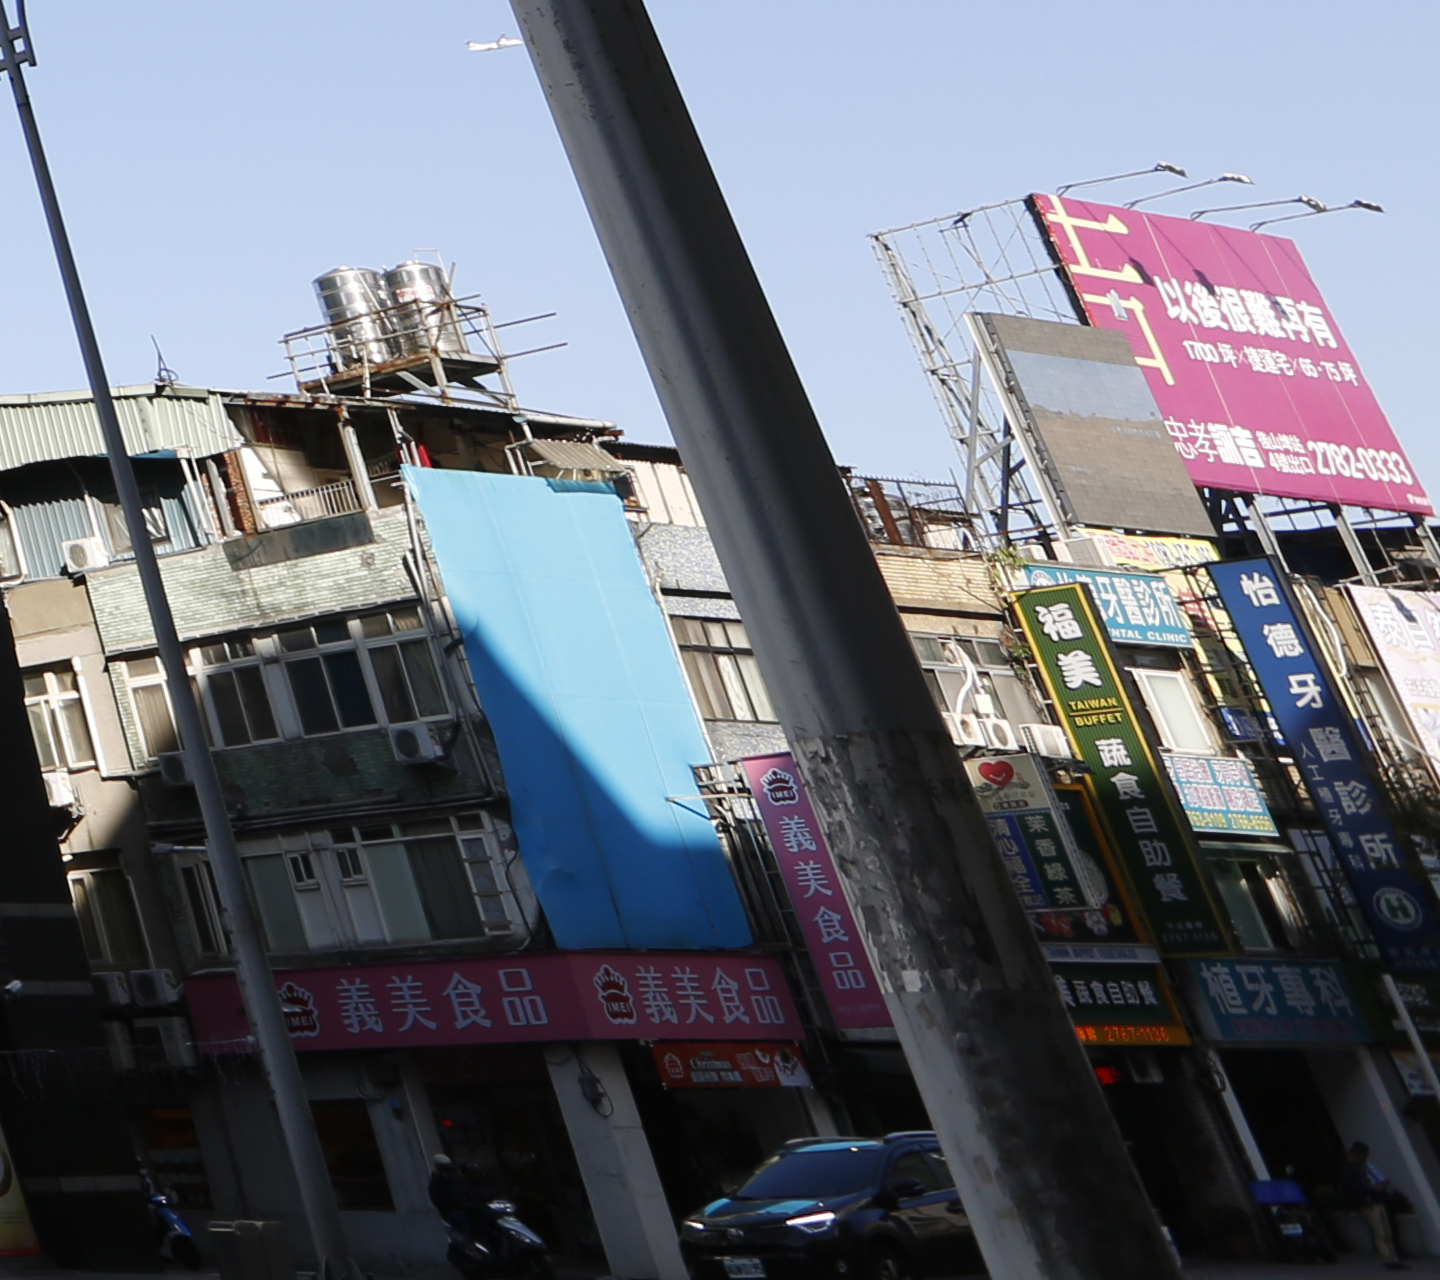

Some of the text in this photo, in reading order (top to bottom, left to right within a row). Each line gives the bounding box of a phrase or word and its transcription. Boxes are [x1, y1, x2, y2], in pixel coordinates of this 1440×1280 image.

[1154, 275, 1339, 350] 以後很難再有
[1305, 441, 1414, 486] 2782-0333
[1035, 602, 1104, 690] 福美
[1147, 630, 1187, 644] CLINIC
[1068, 697, 1119, 711] TAIWAN
[1074, 712, 1125, 727] BUFFET
[1240, 571, 1401, 870] 怡德牙醫診所
[1094, 738, 1188, 902] 蔬食自助餐
[777, 814, 867, 990] 義美食品
[335, 968, 549, 1035] 義美食品
[635, 963, 785, 1026] 義美食品
[1201, 961, 1355, 1017] 植牙專科
